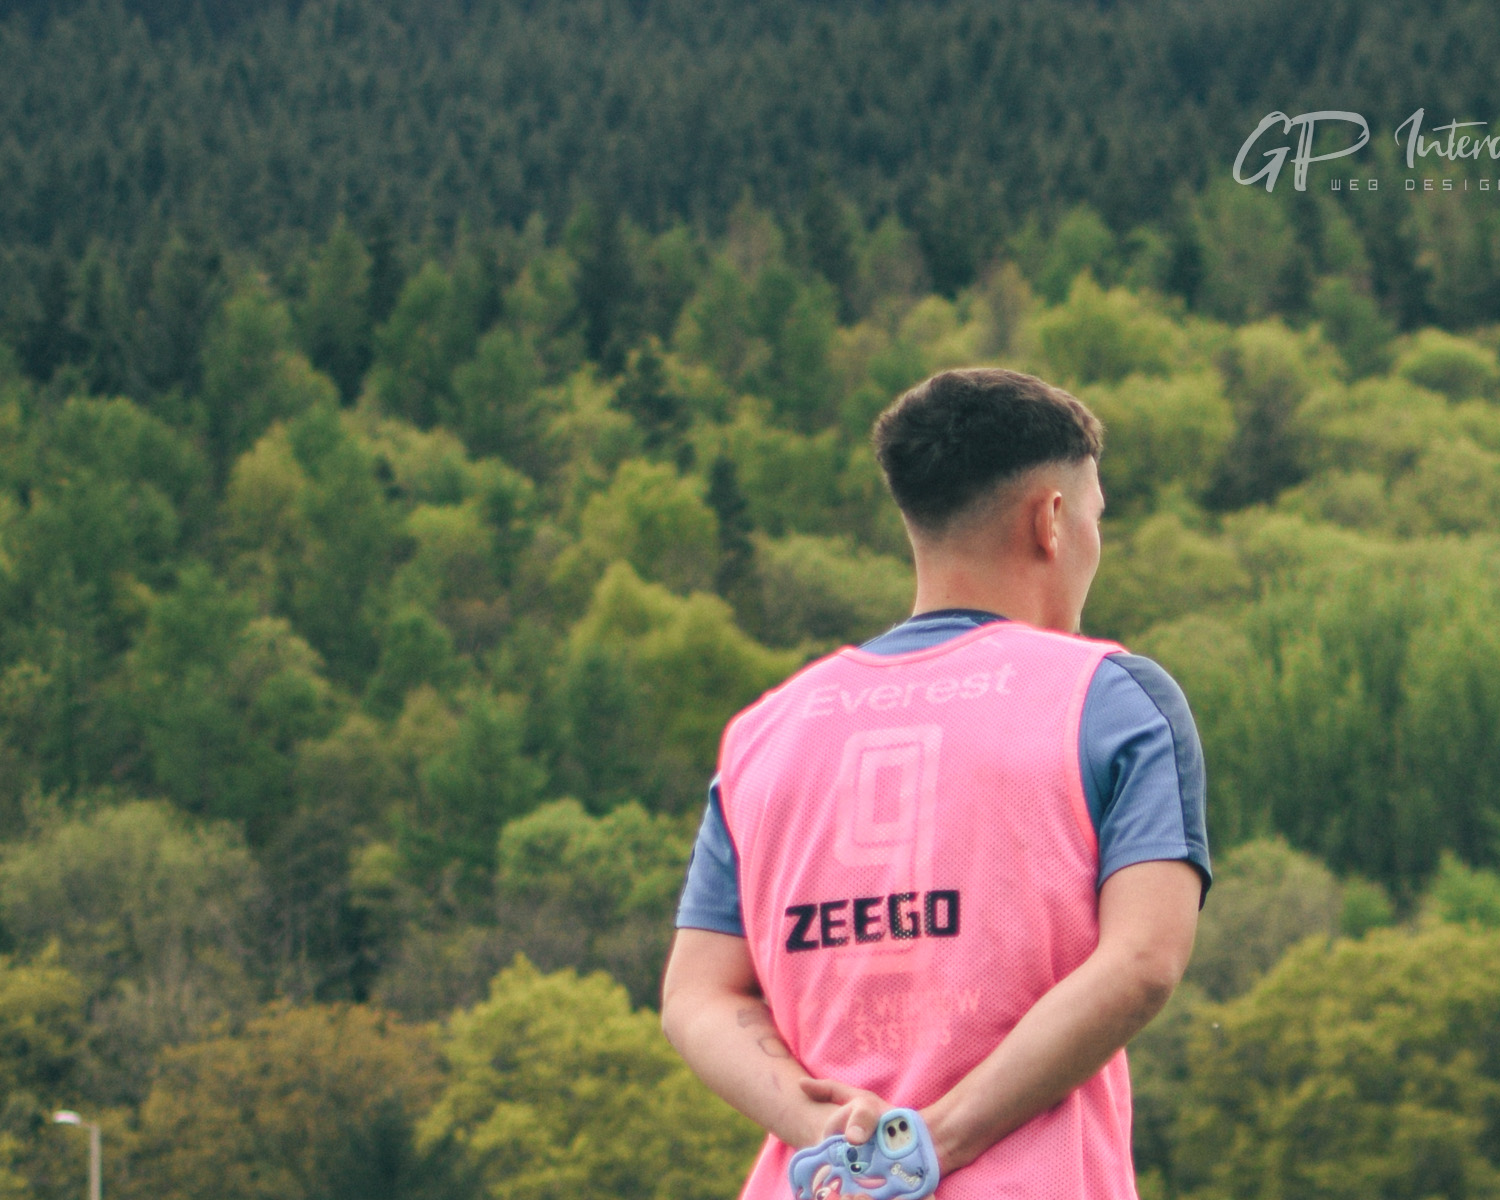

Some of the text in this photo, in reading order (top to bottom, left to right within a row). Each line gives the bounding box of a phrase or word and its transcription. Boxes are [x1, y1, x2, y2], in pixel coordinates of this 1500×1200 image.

[800, 663, 1015, 719] Everest
[833, 722, 944, 978] 9
[785, 889, 961, 954] ZEEGO
